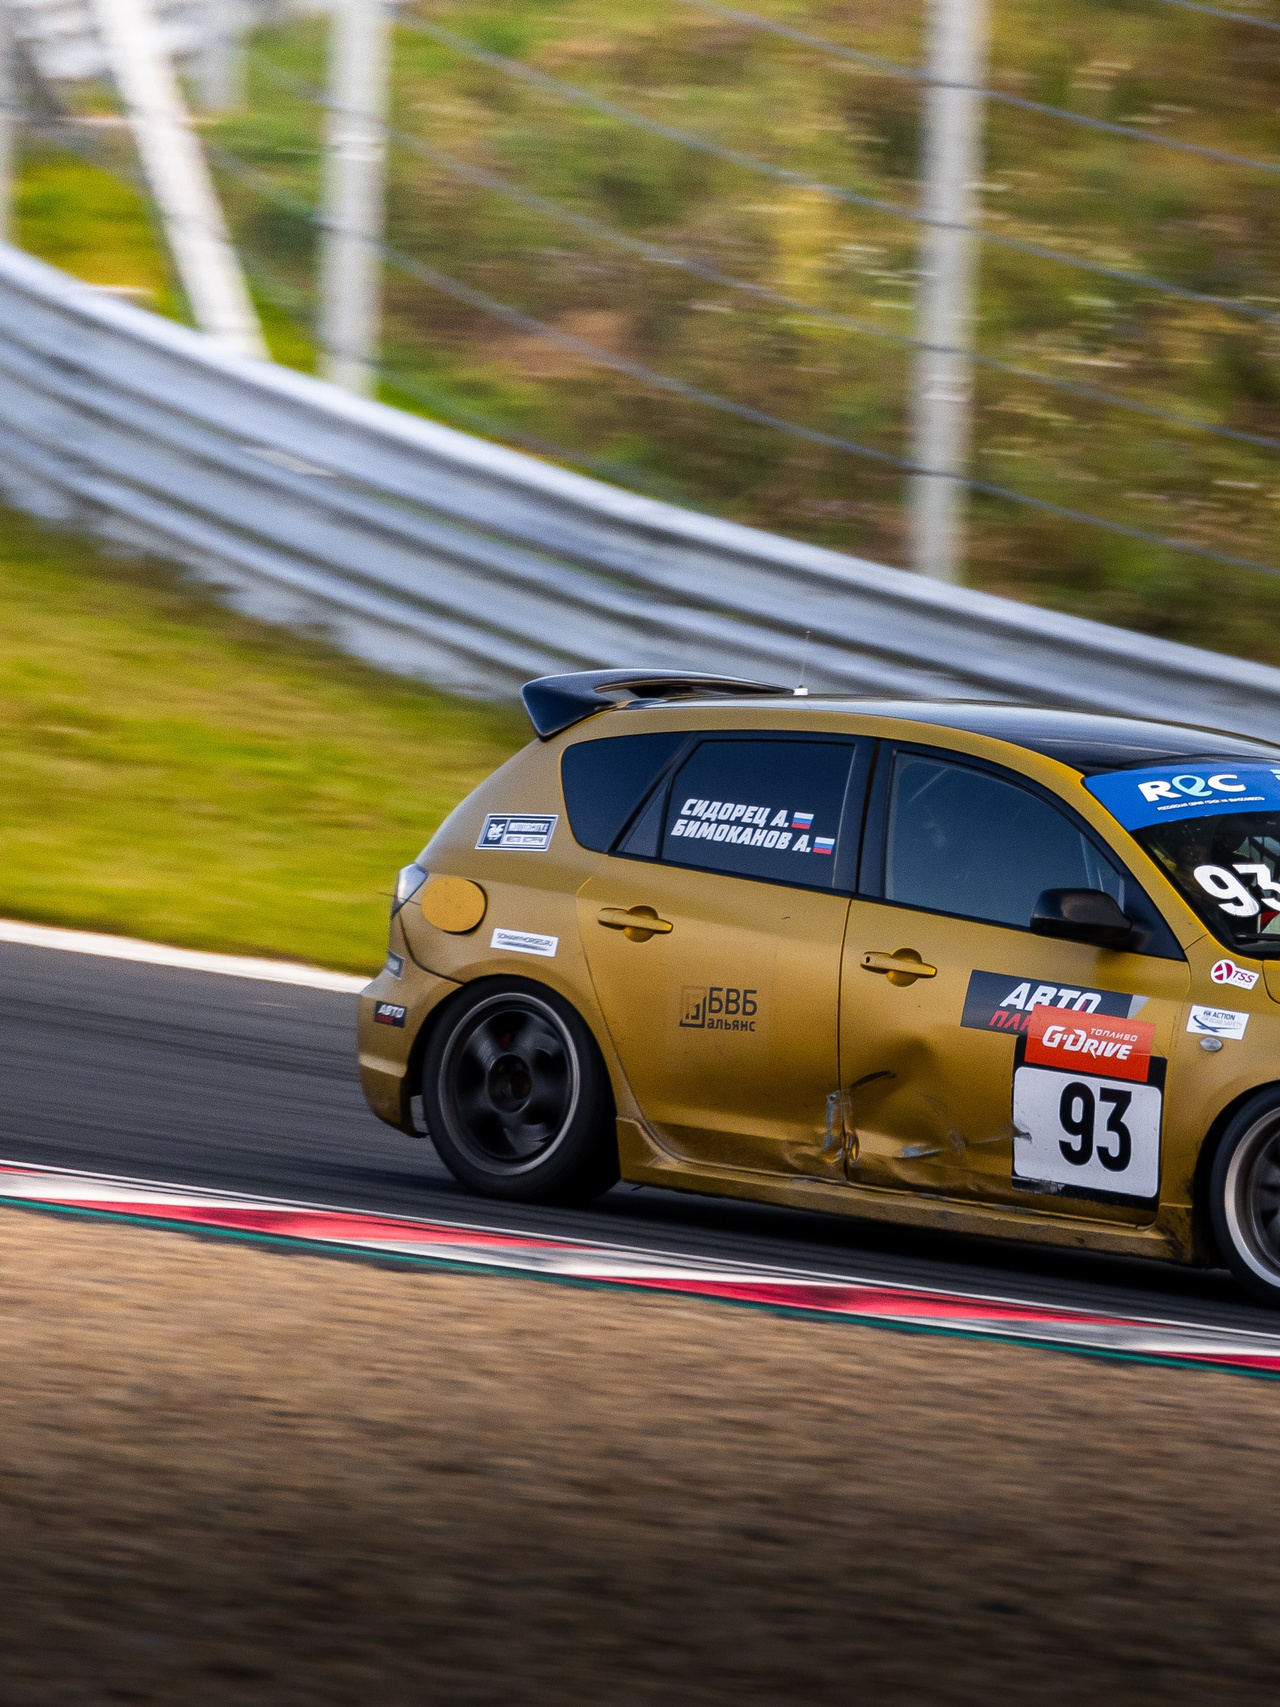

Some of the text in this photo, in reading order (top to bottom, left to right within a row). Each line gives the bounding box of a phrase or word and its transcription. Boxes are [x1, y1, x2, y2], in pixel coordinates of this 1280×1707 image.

[680, 798, 790, 828] СИДОРЕЦ А.
[671, 818, 812, 853] БИМОКАНОВ А.
[378, 1004, 406, 1018] АВТО
[708, 987, 758, 1017] БВБ
[1000, 982, 1102, 1013] АВТО
[707, 1018, 756, 1033] альянс
[1212, 1011, 1236, 1021] ACTION
[1090, 1028, 1139, 1043] ТОПЛИВО
[1058, 1081, 1133, 1173] 93
